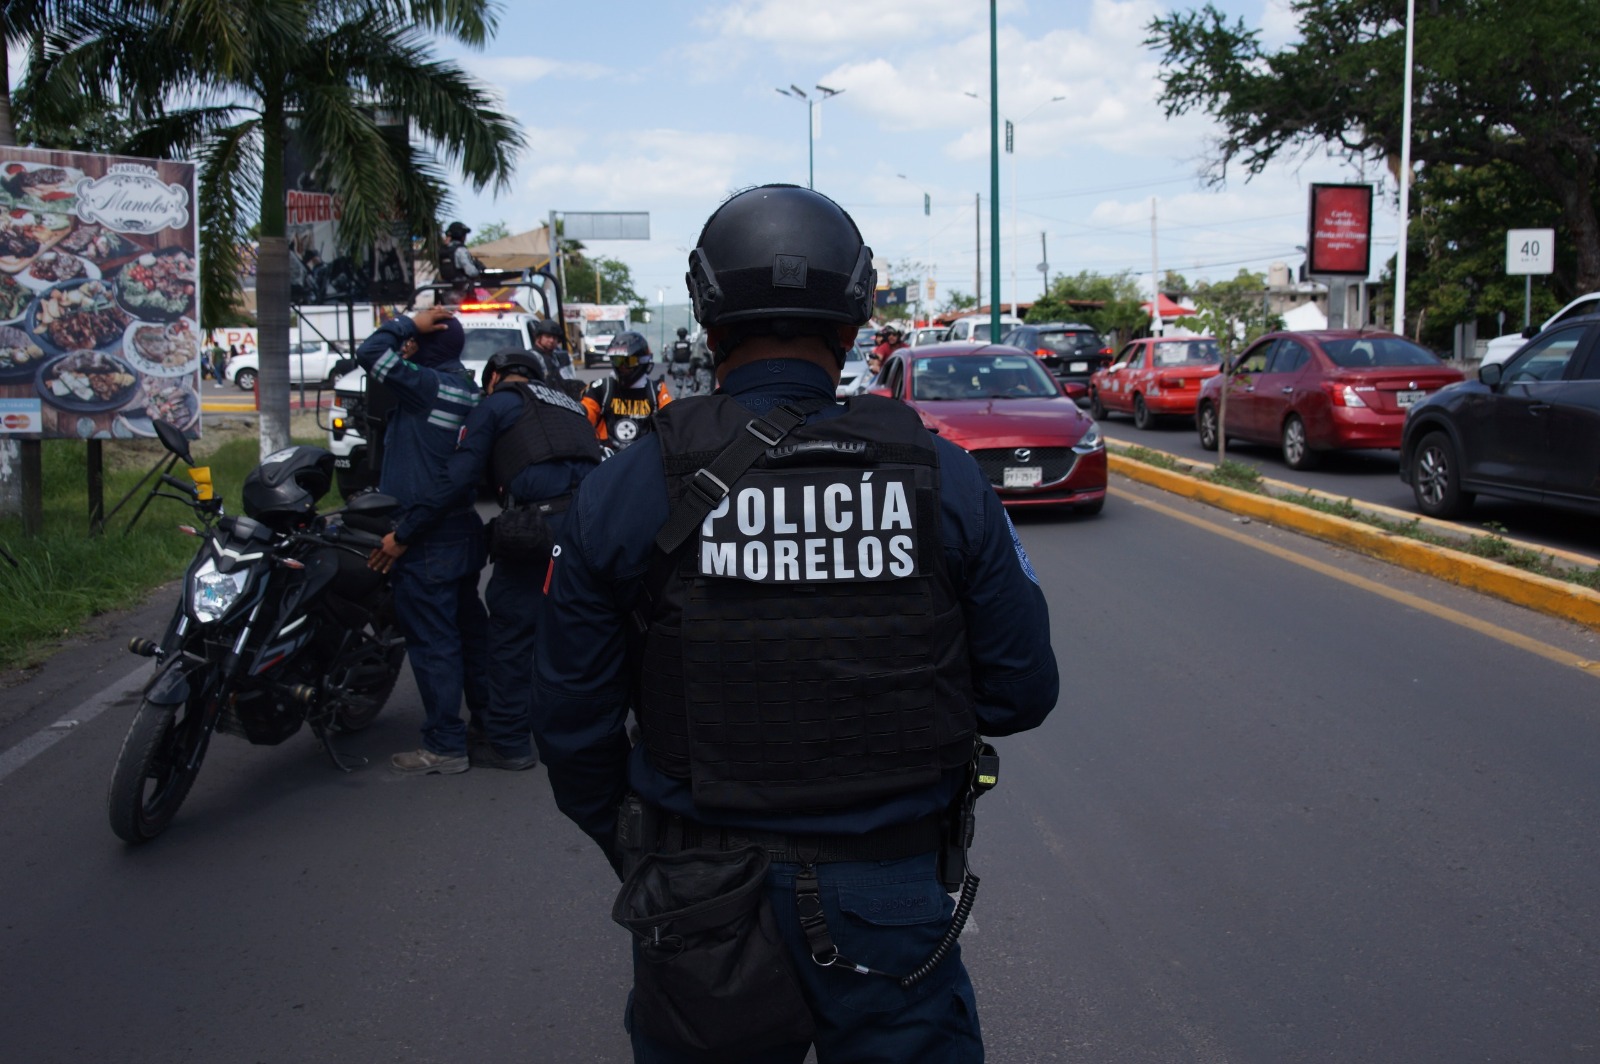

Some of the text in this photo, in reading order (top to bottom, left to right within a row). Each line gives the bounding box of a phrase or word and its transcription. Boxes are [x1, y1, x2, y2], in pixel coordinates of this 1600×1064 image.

[113, 163, 154, 175] PARRILLA
[94, 190, 169, 214] Manolos
[286, 190, 332, 225] POWER
[1521, 240, 1540, 256] 40
[702, 471, 912, 537] POLICÍA
[702, 534, 914, 581] MORELOS
